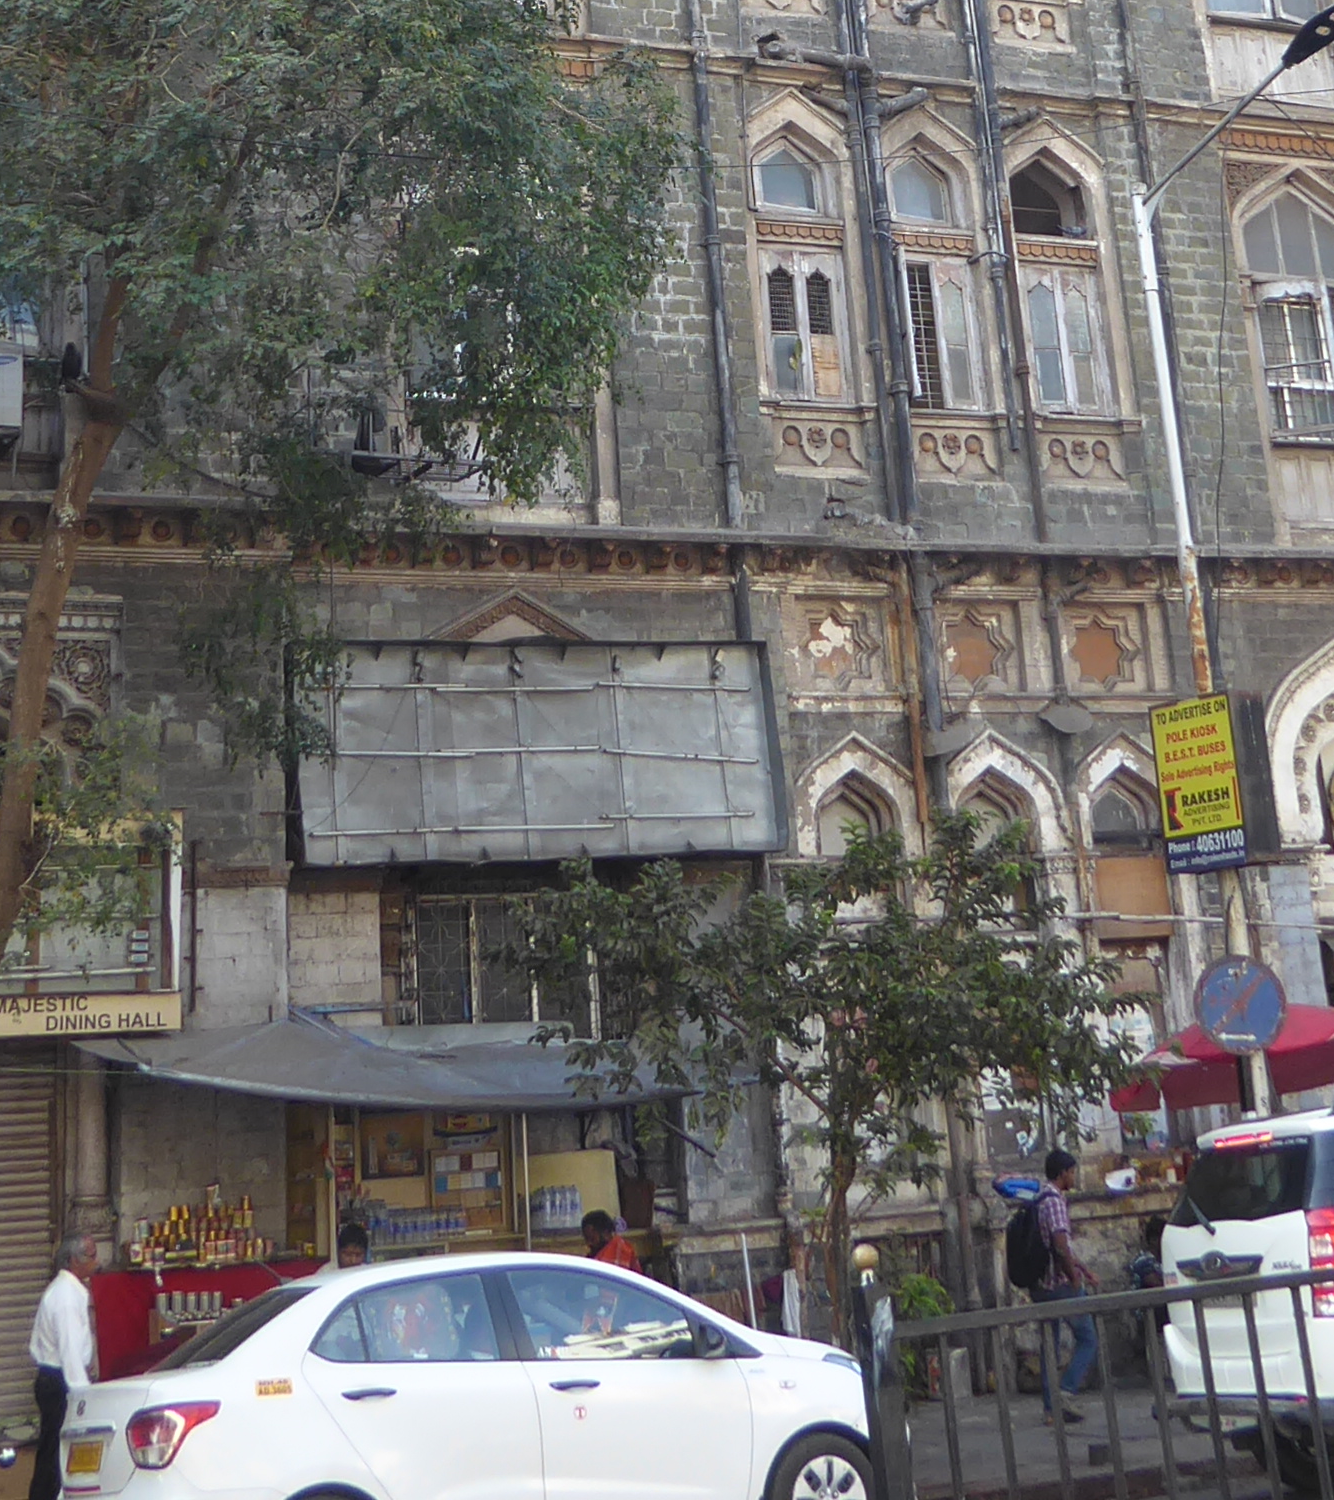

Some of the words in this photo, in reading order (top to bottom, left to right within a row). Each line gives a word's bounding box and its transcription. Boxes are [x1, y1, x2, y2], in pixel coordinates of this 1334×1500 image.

[1156, 713, 1167, 725] TO
[1169, 702, 1212, 723] ADVERTISE
[1214, 699, 1226, 712] ON
[1166, 729, 1188, 744] POLE
[1190, 723, 1218, 738] KIOSK
[1198, 740, 1227, 756] BUSES
[1181, 786, 1230, 807] RAKESH
[1183, 801, 1230, 816] ADVERTISING
[1196, 829, 1244, 852] 40631100
[46, 1014, 112, 1032] DINING
[118, 1012, 167, 1029] HALL
